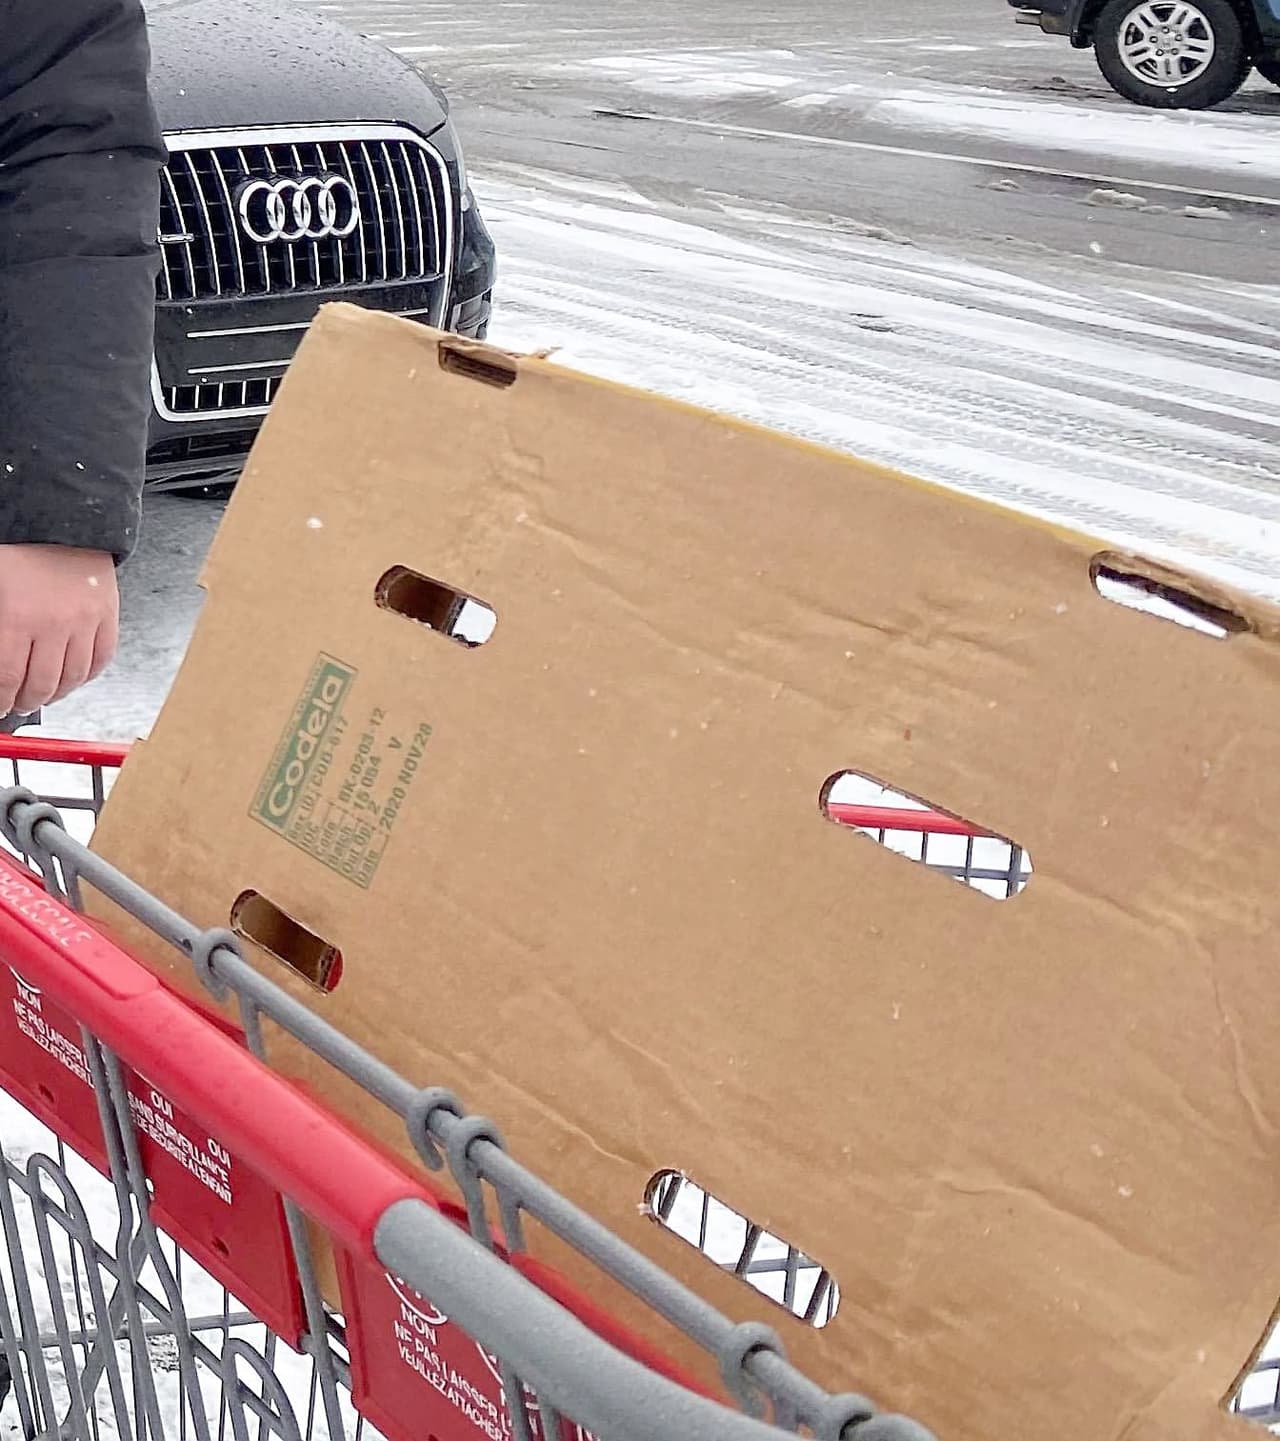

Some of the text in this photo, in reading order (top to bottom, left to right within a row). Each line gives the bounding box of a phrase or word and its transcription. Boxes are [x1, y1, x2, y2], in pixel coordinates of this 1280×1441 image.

[269, 675, 343, 817] Codela
[151, 1090, 173, 1120] OUI
[208, 1137, 231, 1169] OUI
[395, 1320, 412, 1350] NE
[416, 1336, 441, 1370] PAS
[401, 1303, 436, 1346] NON
[399, 1344, 446, 1396] VEUILLEZ
